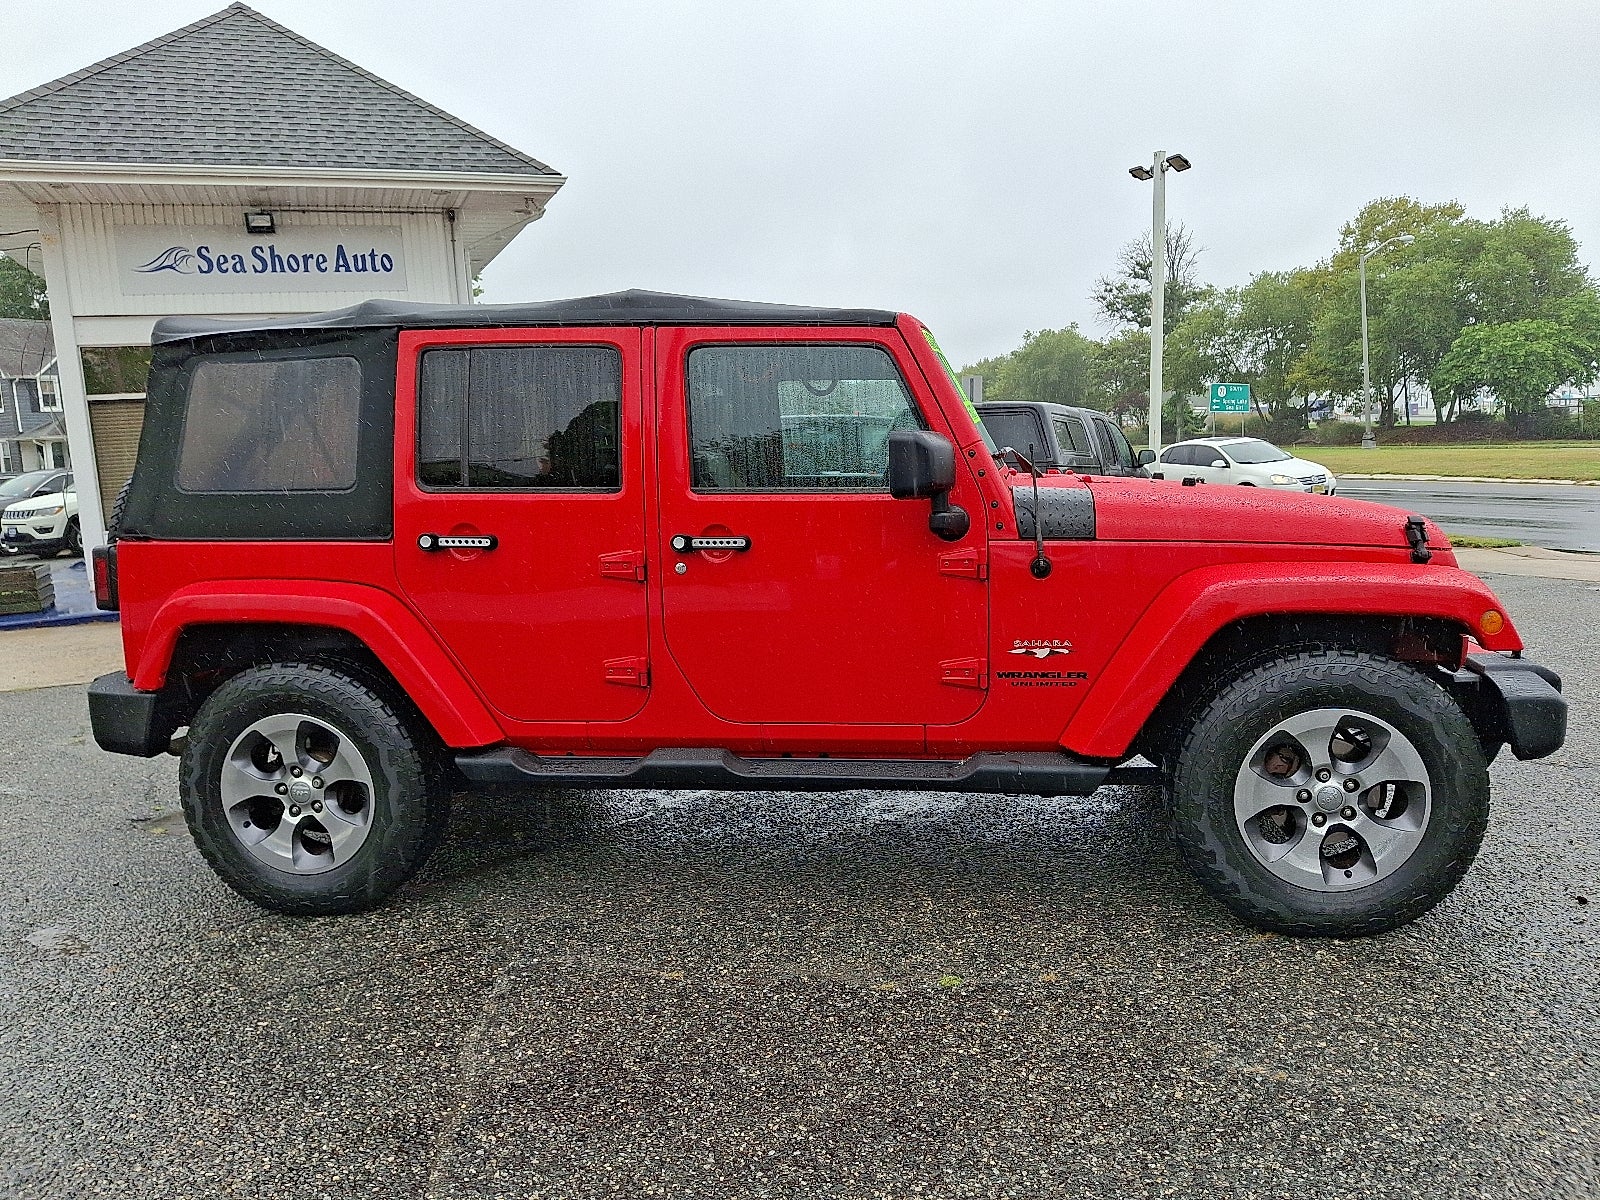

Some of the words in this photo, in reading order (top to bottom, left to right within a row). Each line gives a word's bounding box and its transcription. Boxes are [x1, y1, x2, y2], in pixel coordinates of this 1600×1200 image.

[196, 245, 247, 274] Sea
[251, 244, 328, 273] Shore
[334, 244, 394, 273] Auto
